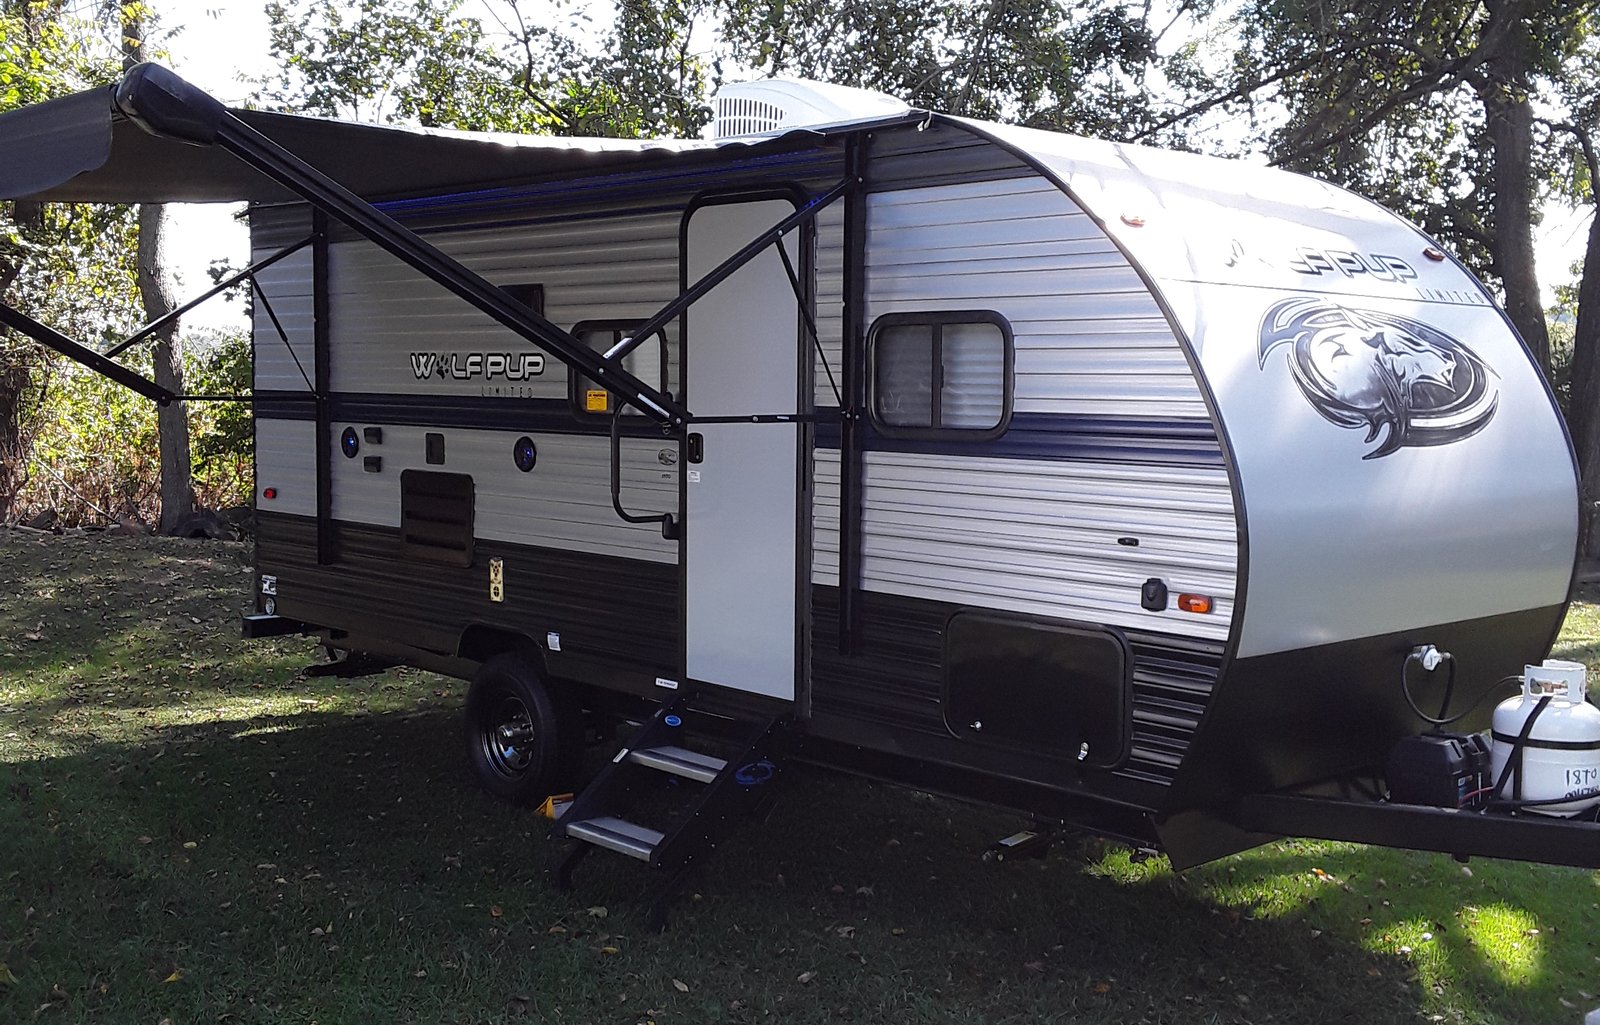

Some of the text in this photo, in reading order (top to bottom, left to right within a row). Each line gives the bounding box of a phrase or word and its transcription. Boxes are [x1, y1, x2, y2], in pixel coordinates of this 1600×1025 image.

[1415, 288, 1485, 304] LIMITED
[410, 352, 545, 381] WLF PUP
[481, 386, 532, 398] LIMITED
